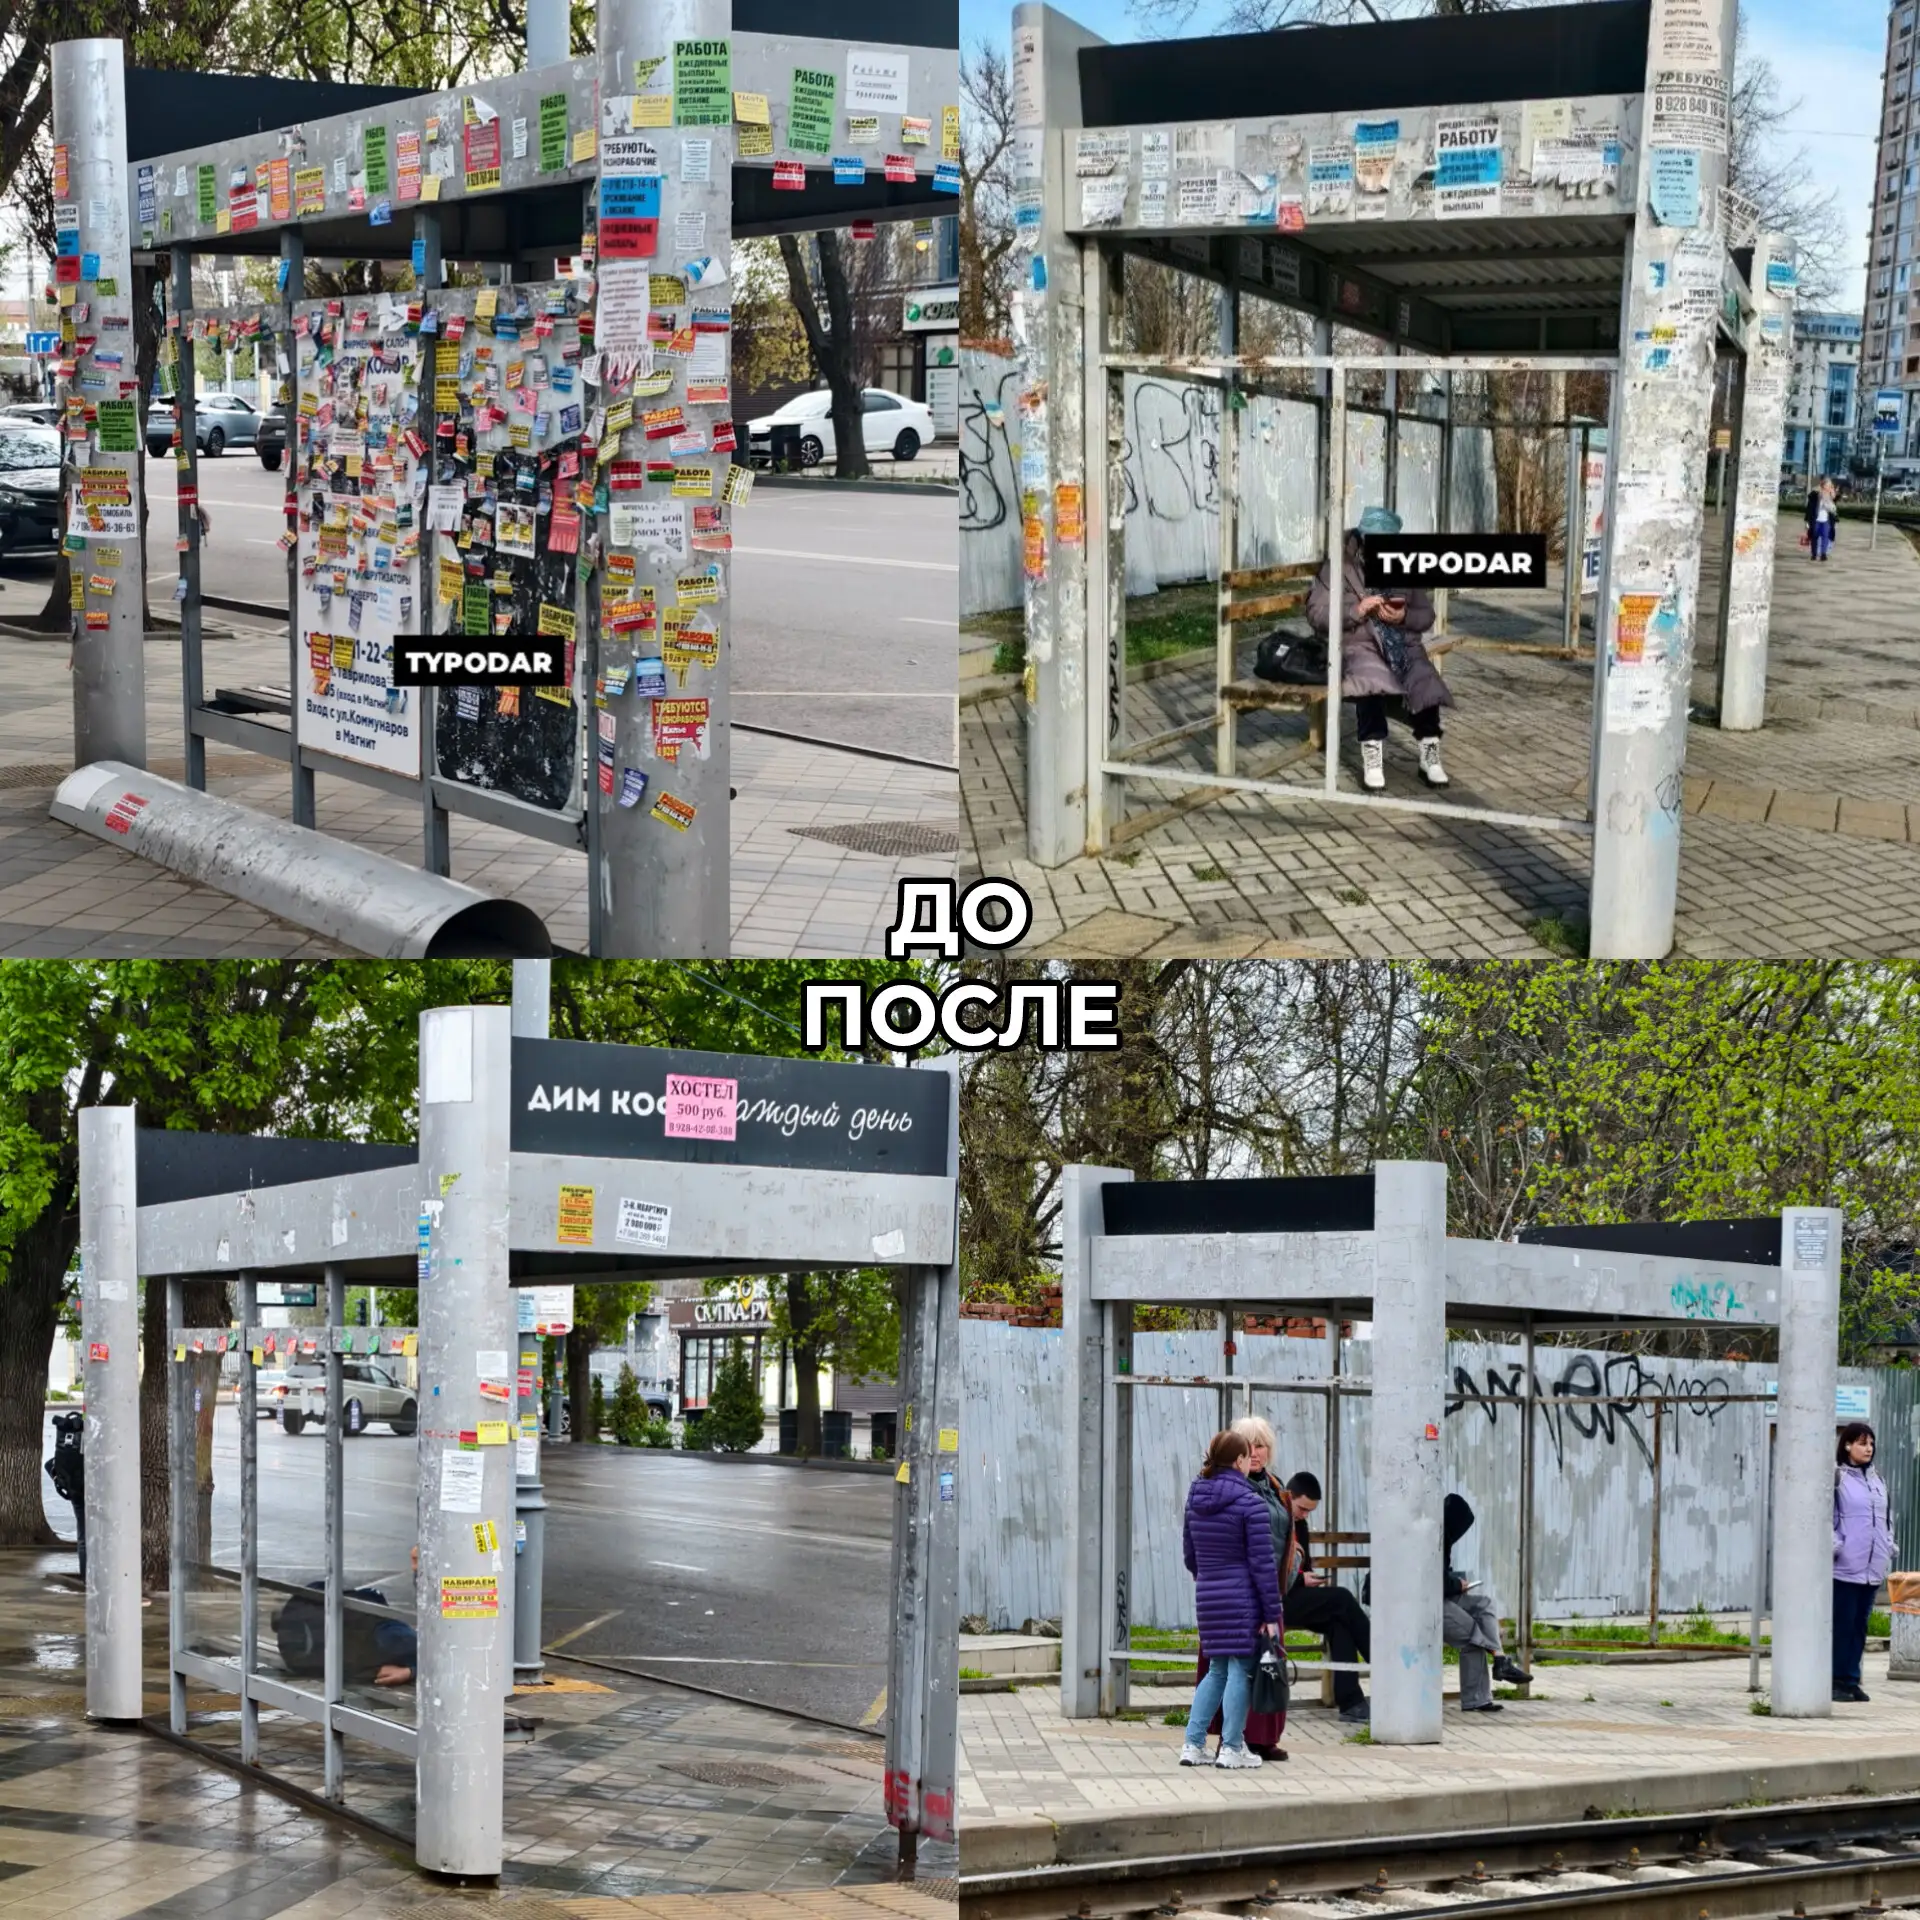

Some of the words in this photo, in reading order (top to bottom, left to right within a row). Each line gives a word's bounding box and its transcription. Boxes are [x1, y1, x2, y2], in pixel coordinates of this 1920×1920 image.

[676, 42, 728, 56] РАБОТА
[794, 69, 835, 88] РАБОТА
[1655, 96, 1663, 112] 8
[1665, 96, 1687, 112] 928
[1439, 129, 1498, 148] РАБОТУ
[1441, 188, 1497, 199] ЕЖЕДНЕВНЫЕ
[1442, 201, 1484, 212] ВЫПЛАТЫ
[100, 400, 134, 410] РАБОТА
[674, 468, 711, 478] РАБОТА
[722, 466, 738, 502] РАБОТА
[677, 577, 715, 587] РАБОТА
[654, 700, 707, 714] ТРЕБУЮТСЯ
[306, 698, 329, 719] Вход
[330, 708, 335, 718] с
[336, 708, 409, 738] ул.Коммунаров
[335, 730, 342, 741] в
[343, 729, 377, 751] Магнит
[670, 1079, 734, 1101] ХОСТЕЛ
[527, 1083, 600, 1113] ДИМ
[735, 1098, 841, 1138] аждый
[848, 1108, 913, 1141] день
[676, 1102, 700, 1116] 500
[702, 1106, 727, 1120] руб.
[669, 1122, 675, 1132] 8
[443, 1578, 496, 1586] НАБИРАЕМ
